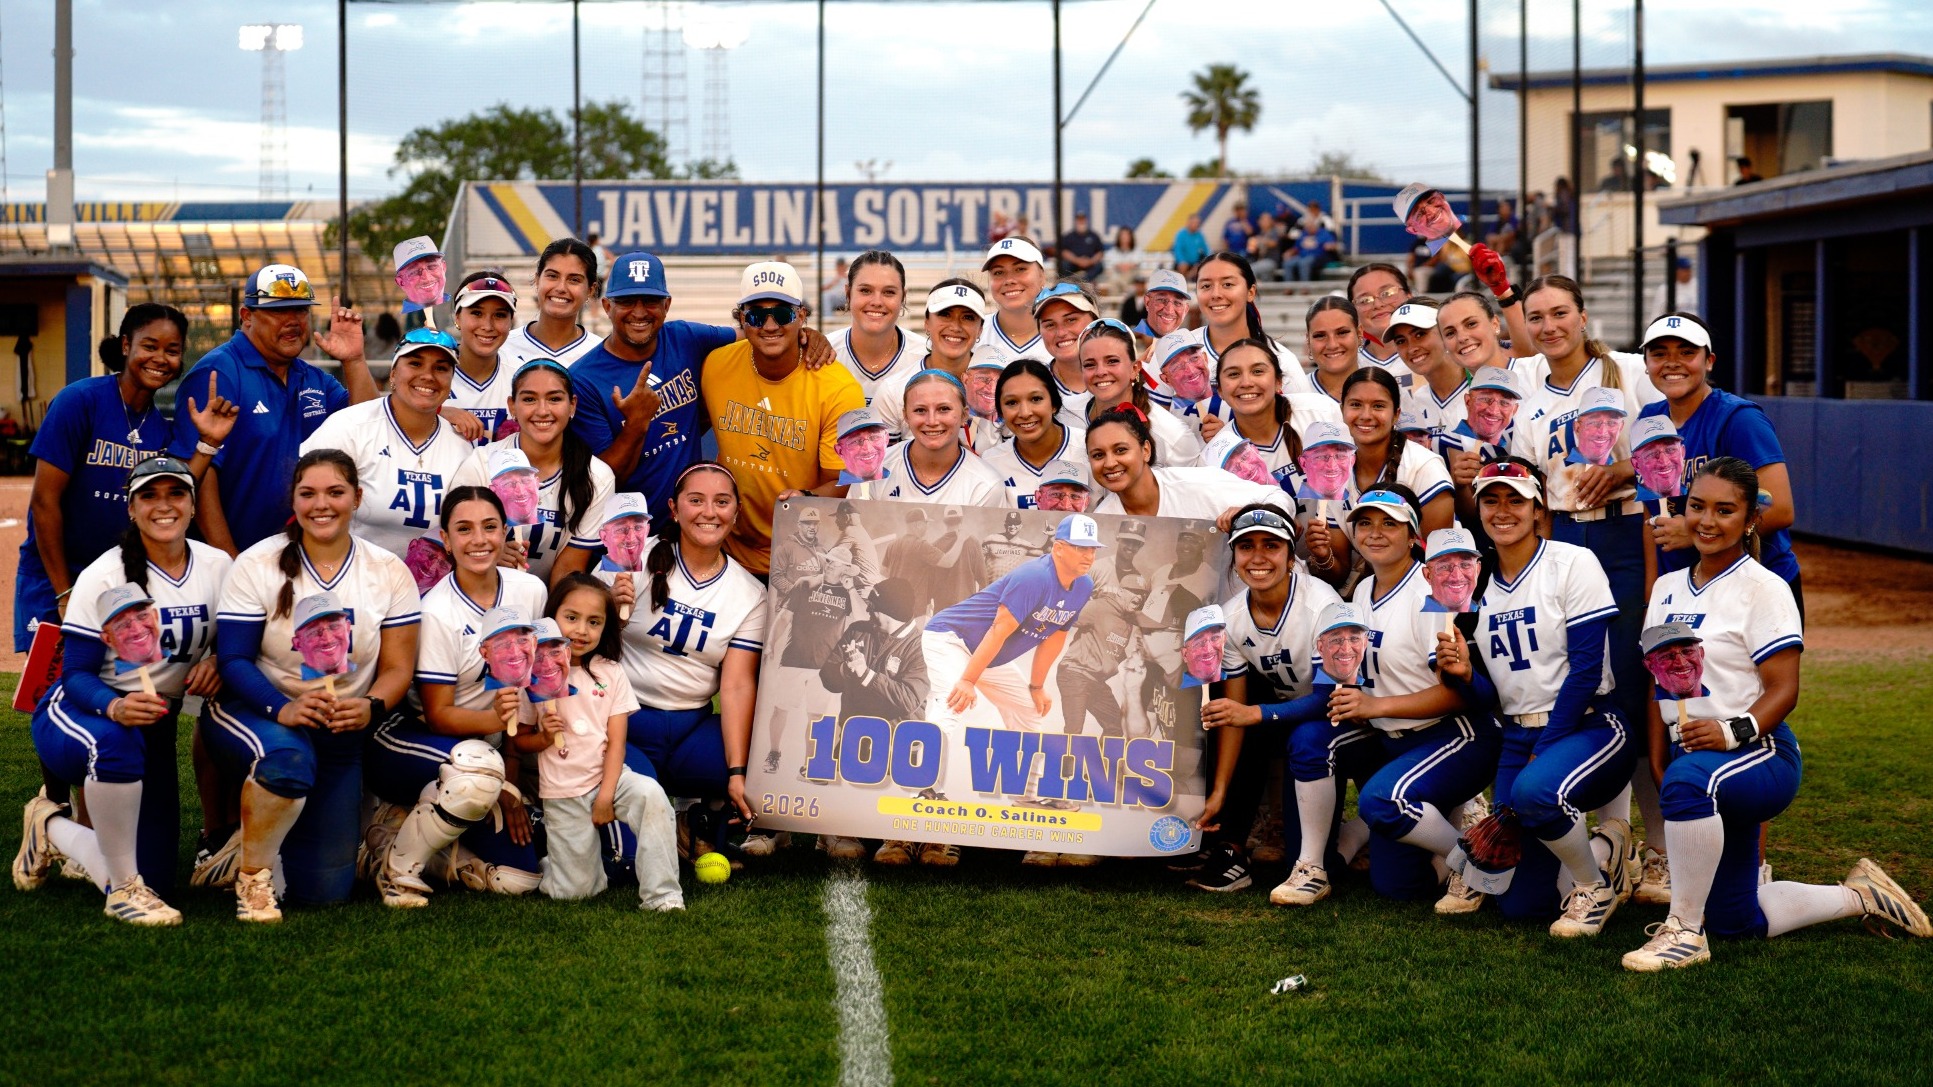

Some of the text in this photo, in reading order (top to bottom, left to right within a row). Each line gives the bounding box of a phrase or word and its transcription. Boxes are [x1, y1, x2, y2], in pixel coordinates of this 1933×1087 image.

[588, 190, 842, 246] JAVELINA
[718, 400, 807, 452] JAVELINAS
[404, 471, 432, 483] TEXAS
[726, 456, 789, 477] SOFTBALL
[167, 606, 200, 617] TEXAS
[674, 602, 705, 619] TEXAS
[1495, 610, 1525, 623] TEXAS
[1671, 614, 1698, 623] TEXAS
[806, 715, 1175, 809] 100 WINS
[762, 793, 820, 818] 2026
[912, 802, 1068, 825] Coach O. Salinas
[893, 818, 1084, 844] ONE HUNDRED CAREER WINS
